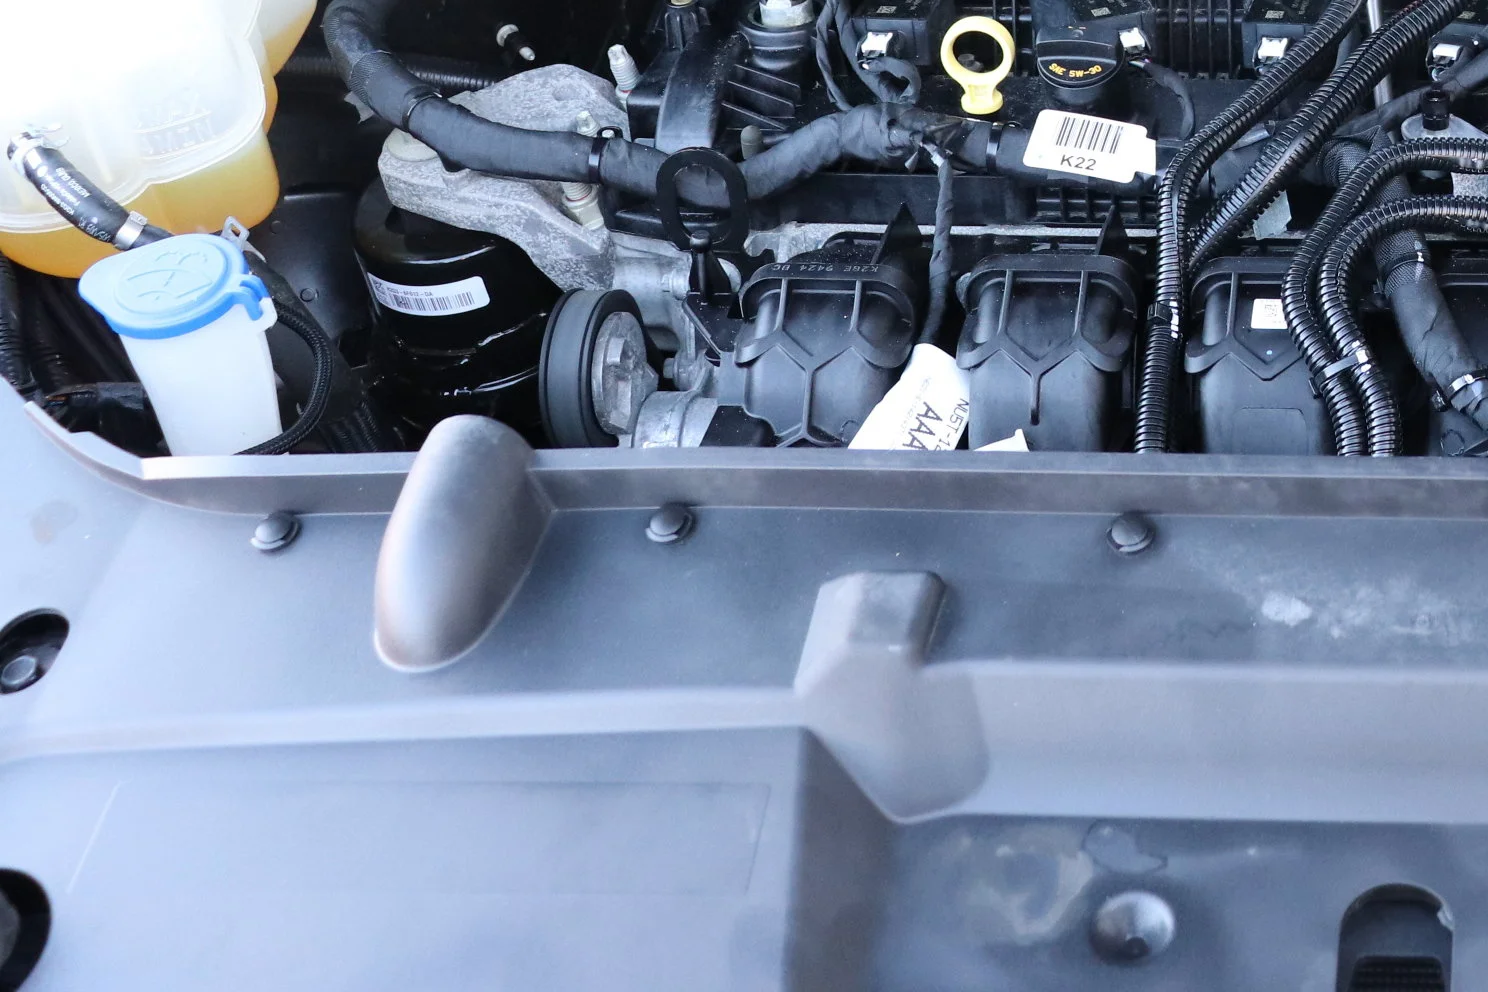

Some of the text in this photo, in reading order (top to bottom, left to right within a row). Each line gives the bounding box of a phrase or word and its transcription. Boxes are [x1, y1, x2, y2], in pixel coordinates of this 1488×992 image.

[1049, 63, 1102, 78] SAE 5W-30
[1060, 154, 1097, 171] K22
